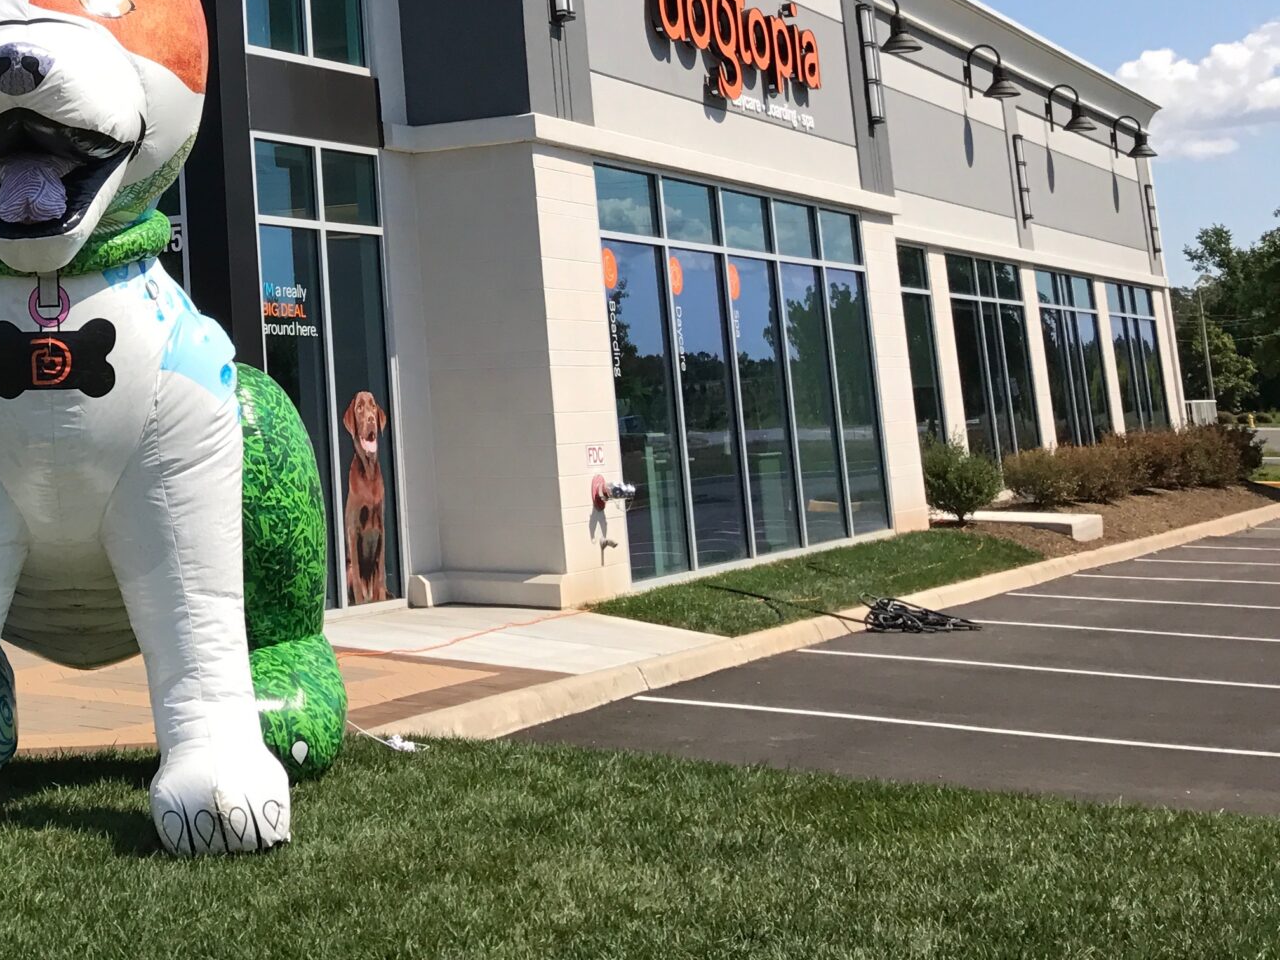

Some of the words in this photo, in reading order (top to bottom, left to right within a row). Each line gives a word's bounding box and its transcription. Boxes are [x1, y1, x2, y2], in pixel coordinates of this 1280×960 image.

[801, 113, 815, 131] spa
[275, 285, 281, 297] a
[282, 283, 307, 302] really
[263, 302, 279, 317] BIG
[280, 302, 307, 318] DEAL
[263, 321, 295, 336] around
[295, 321, 319, 337] here.
[608, 300, 622, 378] Boarding
[675, 306, 687, 372] Daycare
[587, 446, 604, 464] FDC
